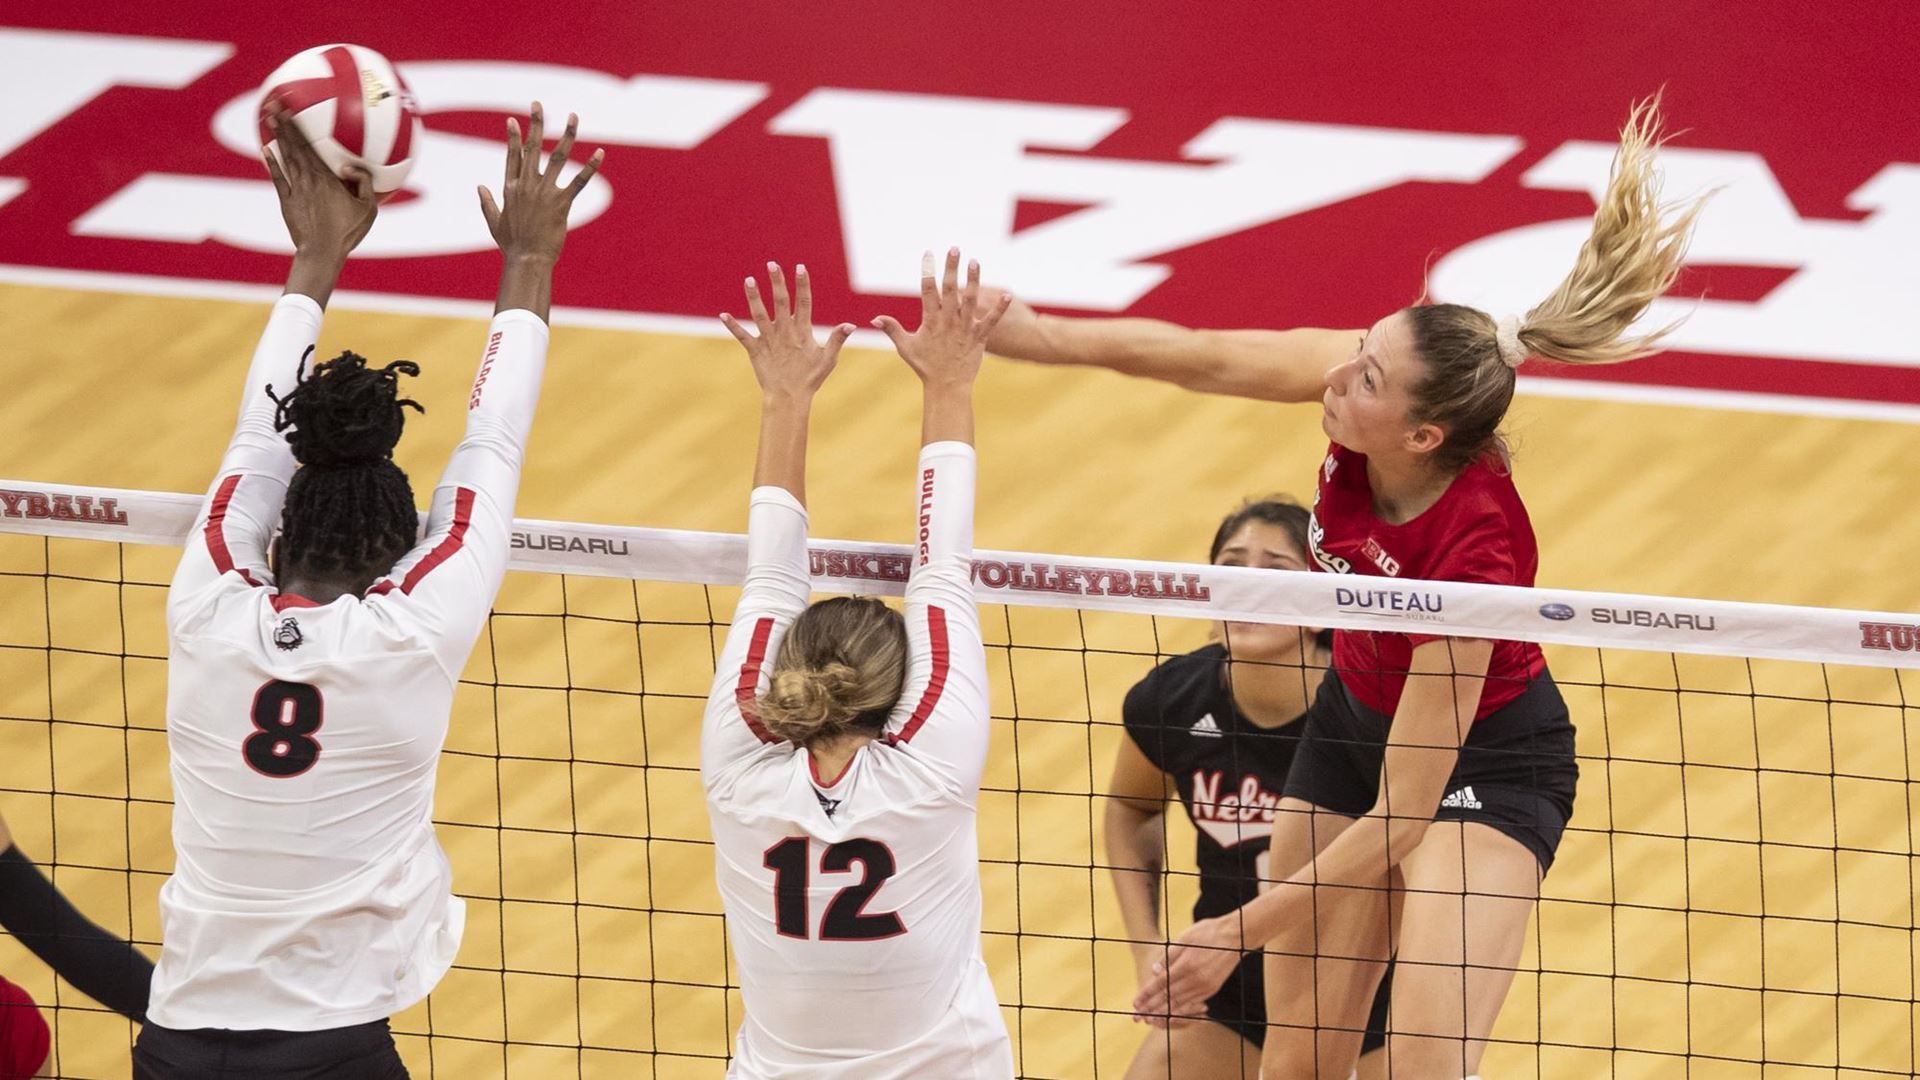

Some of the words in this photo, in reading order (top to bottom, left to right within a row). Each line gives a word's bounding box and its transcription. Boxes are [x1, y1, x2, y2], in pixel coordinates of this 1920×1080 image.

[469, 331, 503, 411] BULLDOGS
[0, 488, 128, 526] YBALL
[919, 468, 935, 567] BULLDOGS
[510, 532, 629, 556] SUBARU
[808, 548, 913, 583] USKE
[1335, 587, 1443, 613] DUTEAU
[1591, 607, 1716, 631] SUBARU
[1859, 621, 1920, 652] HU
[242, 678, 325, 779] 8
[1191, 767, 1282, 823] Nebr
[762, 836, 909, 942] 12
